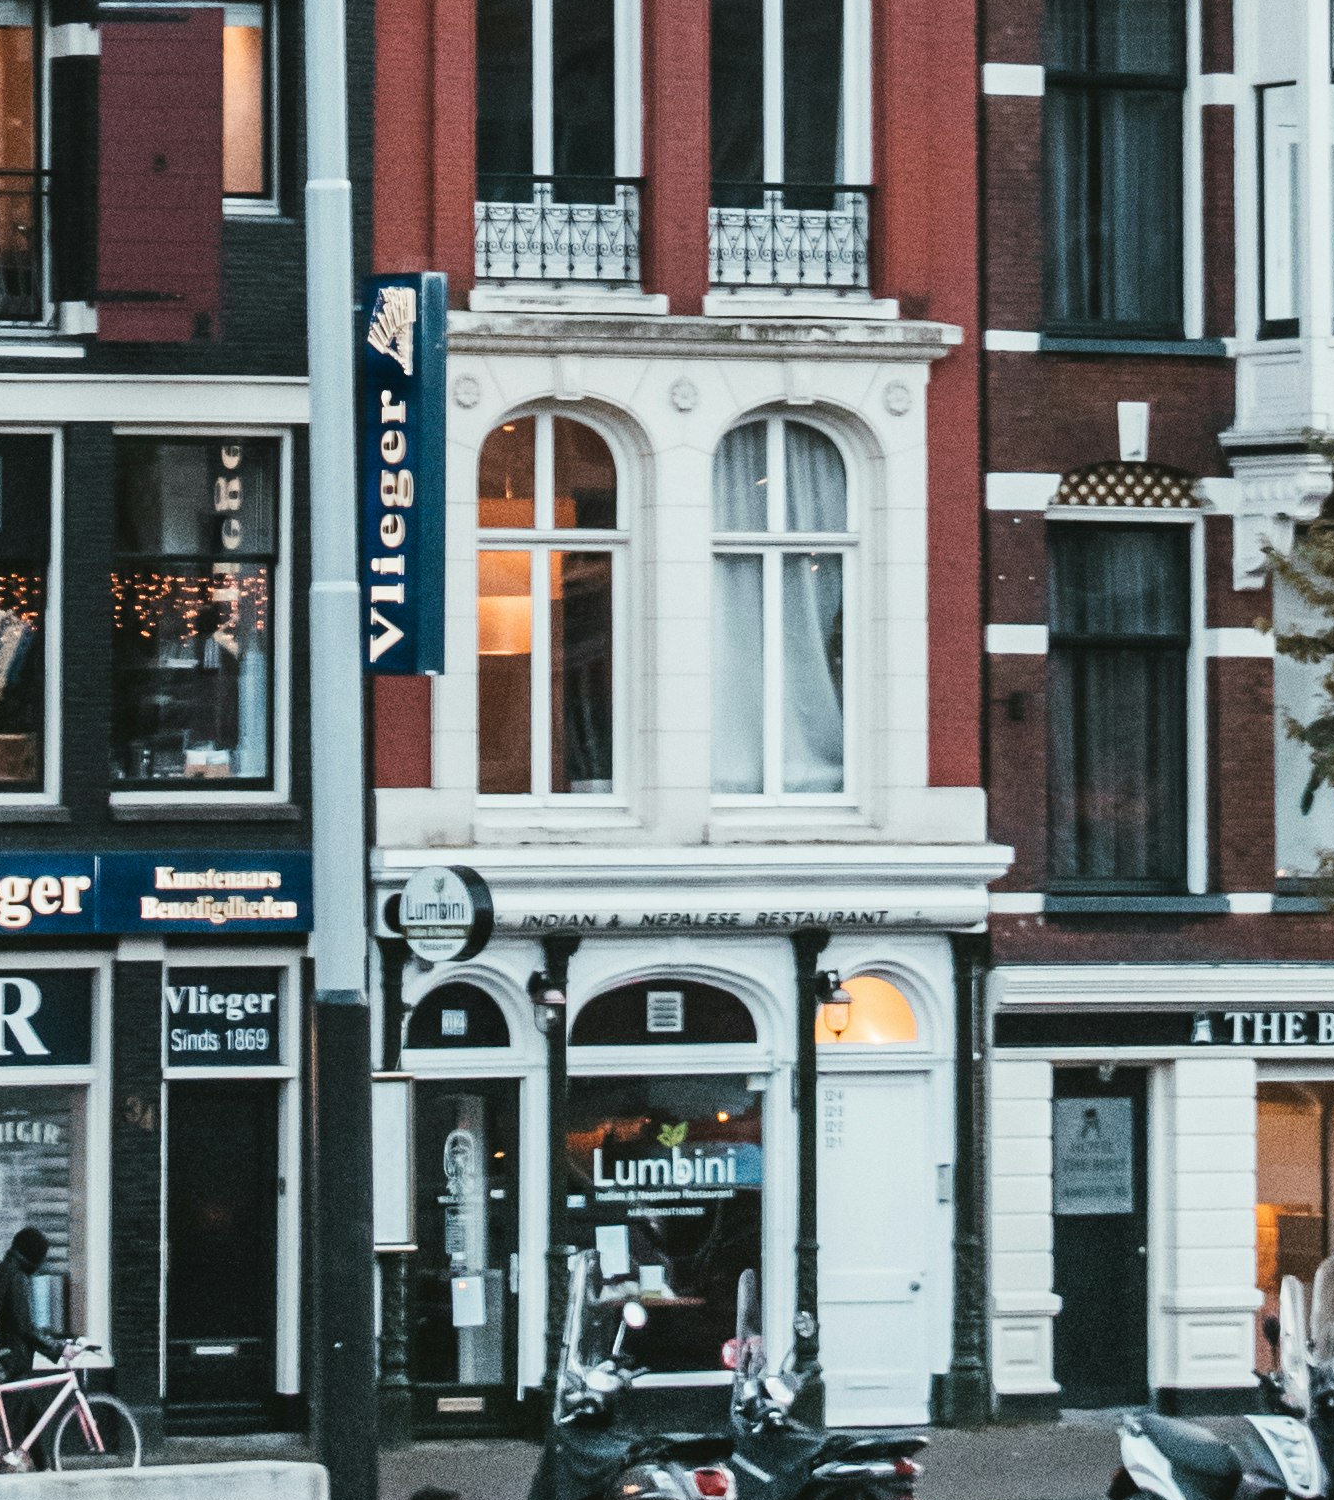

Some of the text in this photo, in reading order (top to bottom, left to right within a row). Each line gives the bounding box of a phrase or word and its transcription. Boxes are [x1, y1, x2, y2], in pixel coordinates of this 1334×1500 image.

[370, 389, 414, 663] Vlieger
[154, 866, 282, 889] Kunstenaars
[141, 895, 298, 924] Benodigdheden
[406, 894, 465, 921] Lumbini
[520, 914, 597, 929] INDIAN
[639, 912, 741, 927] NEPALESE
[754, 911, 889, 926] RESTAURANT
[166, 985, 277, 1020] Vlieger
[170, 1028, 270, 1052] Sinds 1869
[1224, 1011, 1308, 1044] THE
[593, 1146, 736, 1187] Lumbini
[682, 1189, 735, 1199] Restaurant
